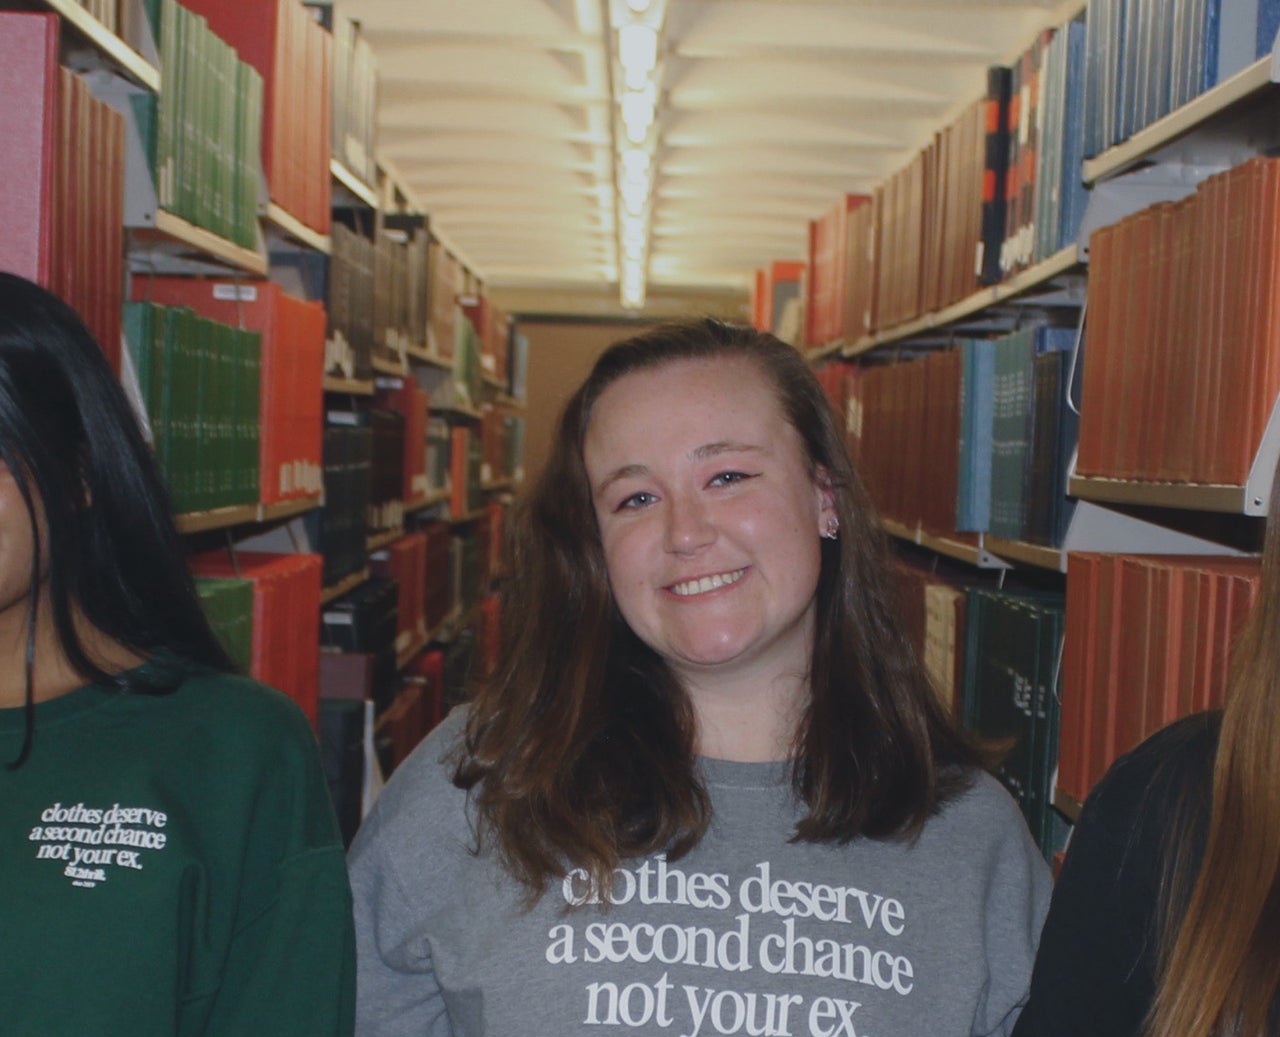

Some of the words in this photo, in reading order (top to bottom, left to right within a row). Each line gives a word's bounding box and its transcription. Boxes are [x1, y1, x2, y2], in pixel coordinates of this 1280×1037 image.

[40, 802, 104, 824] clothes
[103, 803, 168, 828] deserve
[28, 826, 42, 841] a
[42, 823, 106, 845] second
[103, 823, 167, 850] chance
[35, 843, 72, 860] not
[68, 847, 117, 866] your
[116, 851, 143, 870] ex.
[739, 860, 906, 936] deserve
[545, 922, 578, 964] a
[583, 914, 753, 972] second
[758, 917, 914, 996] chance
[583, 972, 674, 1027] not
